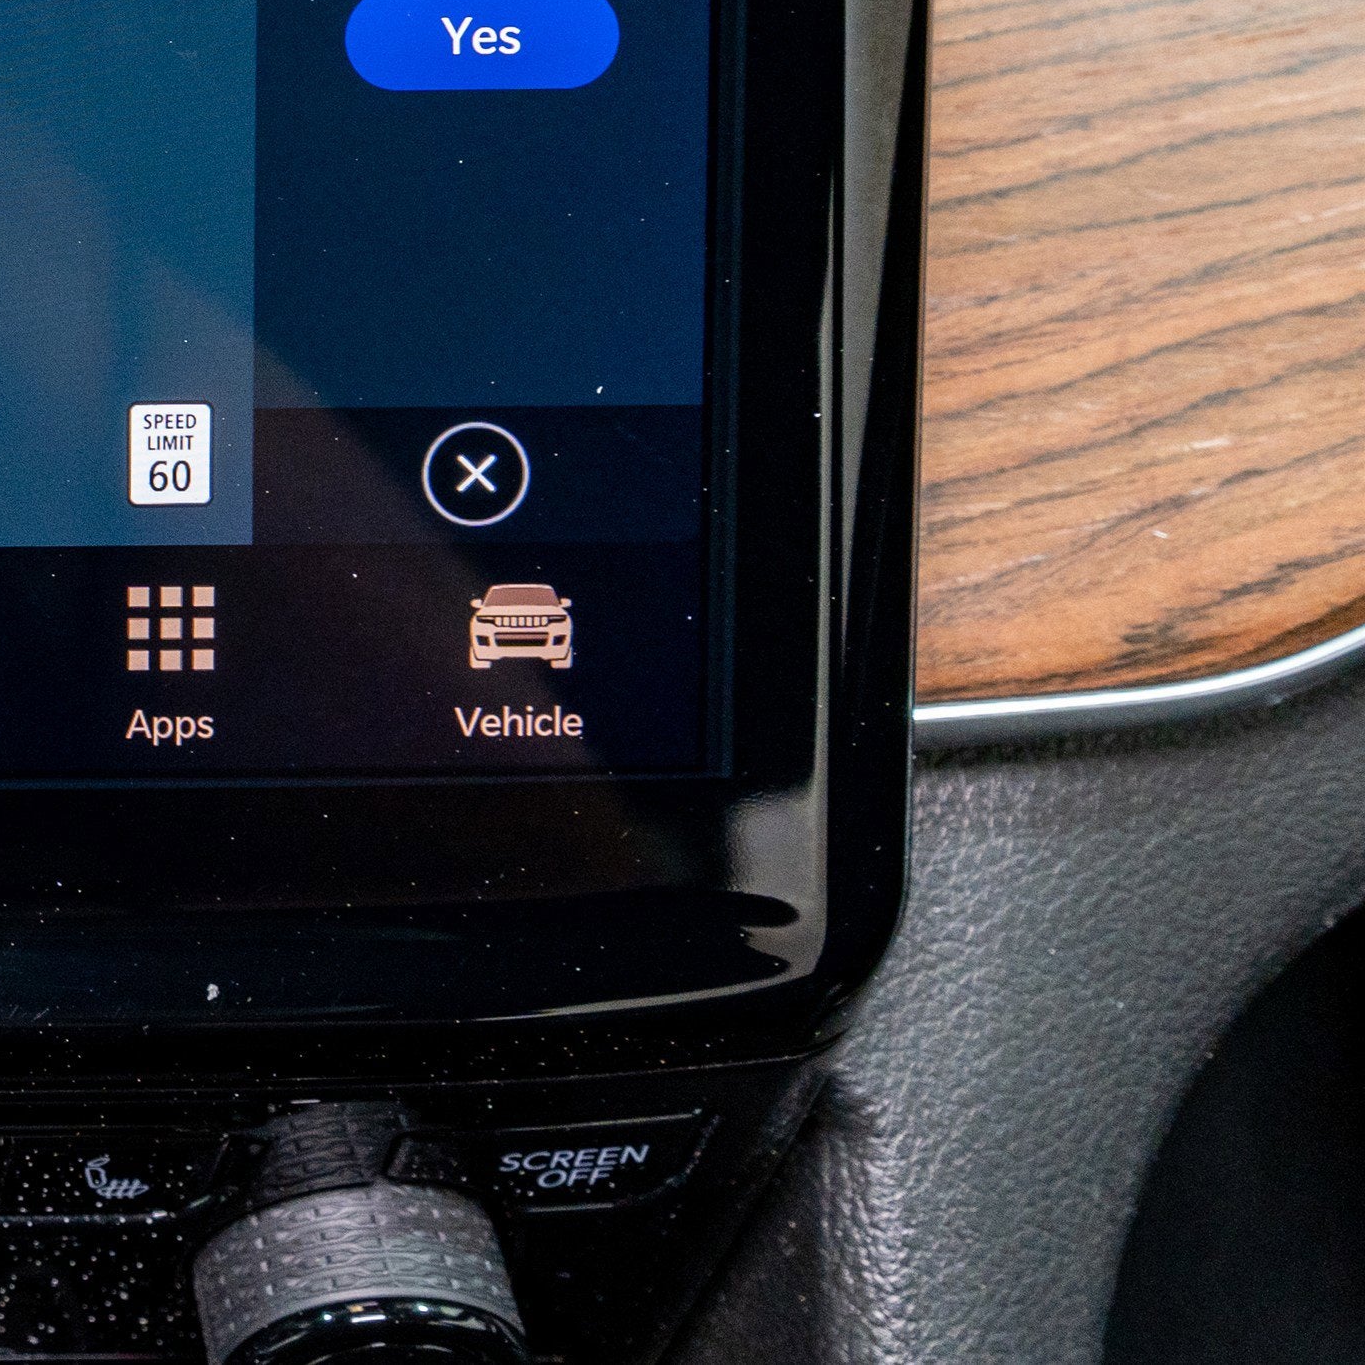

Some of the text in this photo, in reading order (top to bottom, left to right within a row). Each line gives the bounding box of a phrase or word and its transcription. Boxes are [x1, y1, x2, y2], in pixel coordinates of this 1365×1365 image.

[441, 17, 520, 54] Yes
[144, 414, 196, 429] SPEED
[148, 435, 193, 450] LIMIT
[149, 461, 191, 491] 60
[126, 710, 213, 746] Apps
[455, 706, 583, 736] Vehicle
[500, 1145, 649, 1172] SCREEN
[537, 1168, 615, 1187] OFF
